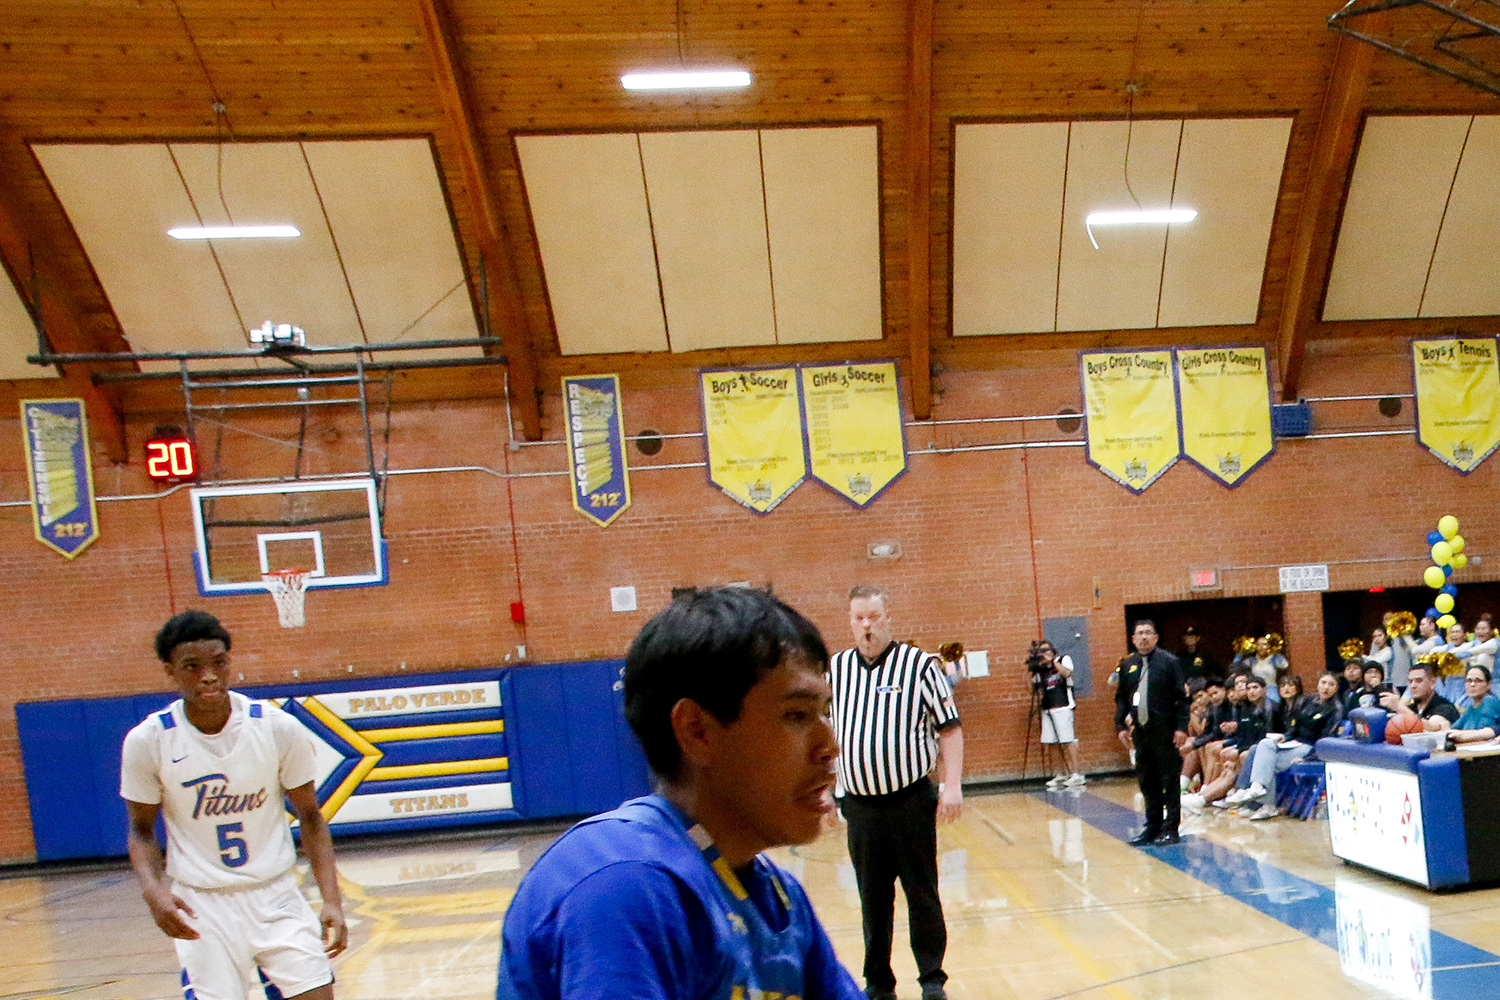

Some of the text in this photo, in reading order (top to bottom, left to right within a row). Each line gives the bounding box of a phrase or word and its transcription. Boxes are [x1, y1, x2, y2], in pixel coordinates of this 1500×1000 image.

[1181, 350, 1262, 371] Girls Cross Country
[1421, 340, 1491, 360] Boys Tennis
[1088, 354, 1168, 376] Boys Cross Country
[711, 372, 788, 394] Boys Soccer
[812, 366, 885, 388] Girls Soccer
[568, 383, 589, 497] RESPECT
[146, 441, 194, 477] 20
[349, 688, 487, 714] PALO VERDE
[180, 773, 269, 820] Titans
[389, 793, 470, 814] TITANS
[216, 822, 250, 868] 5
